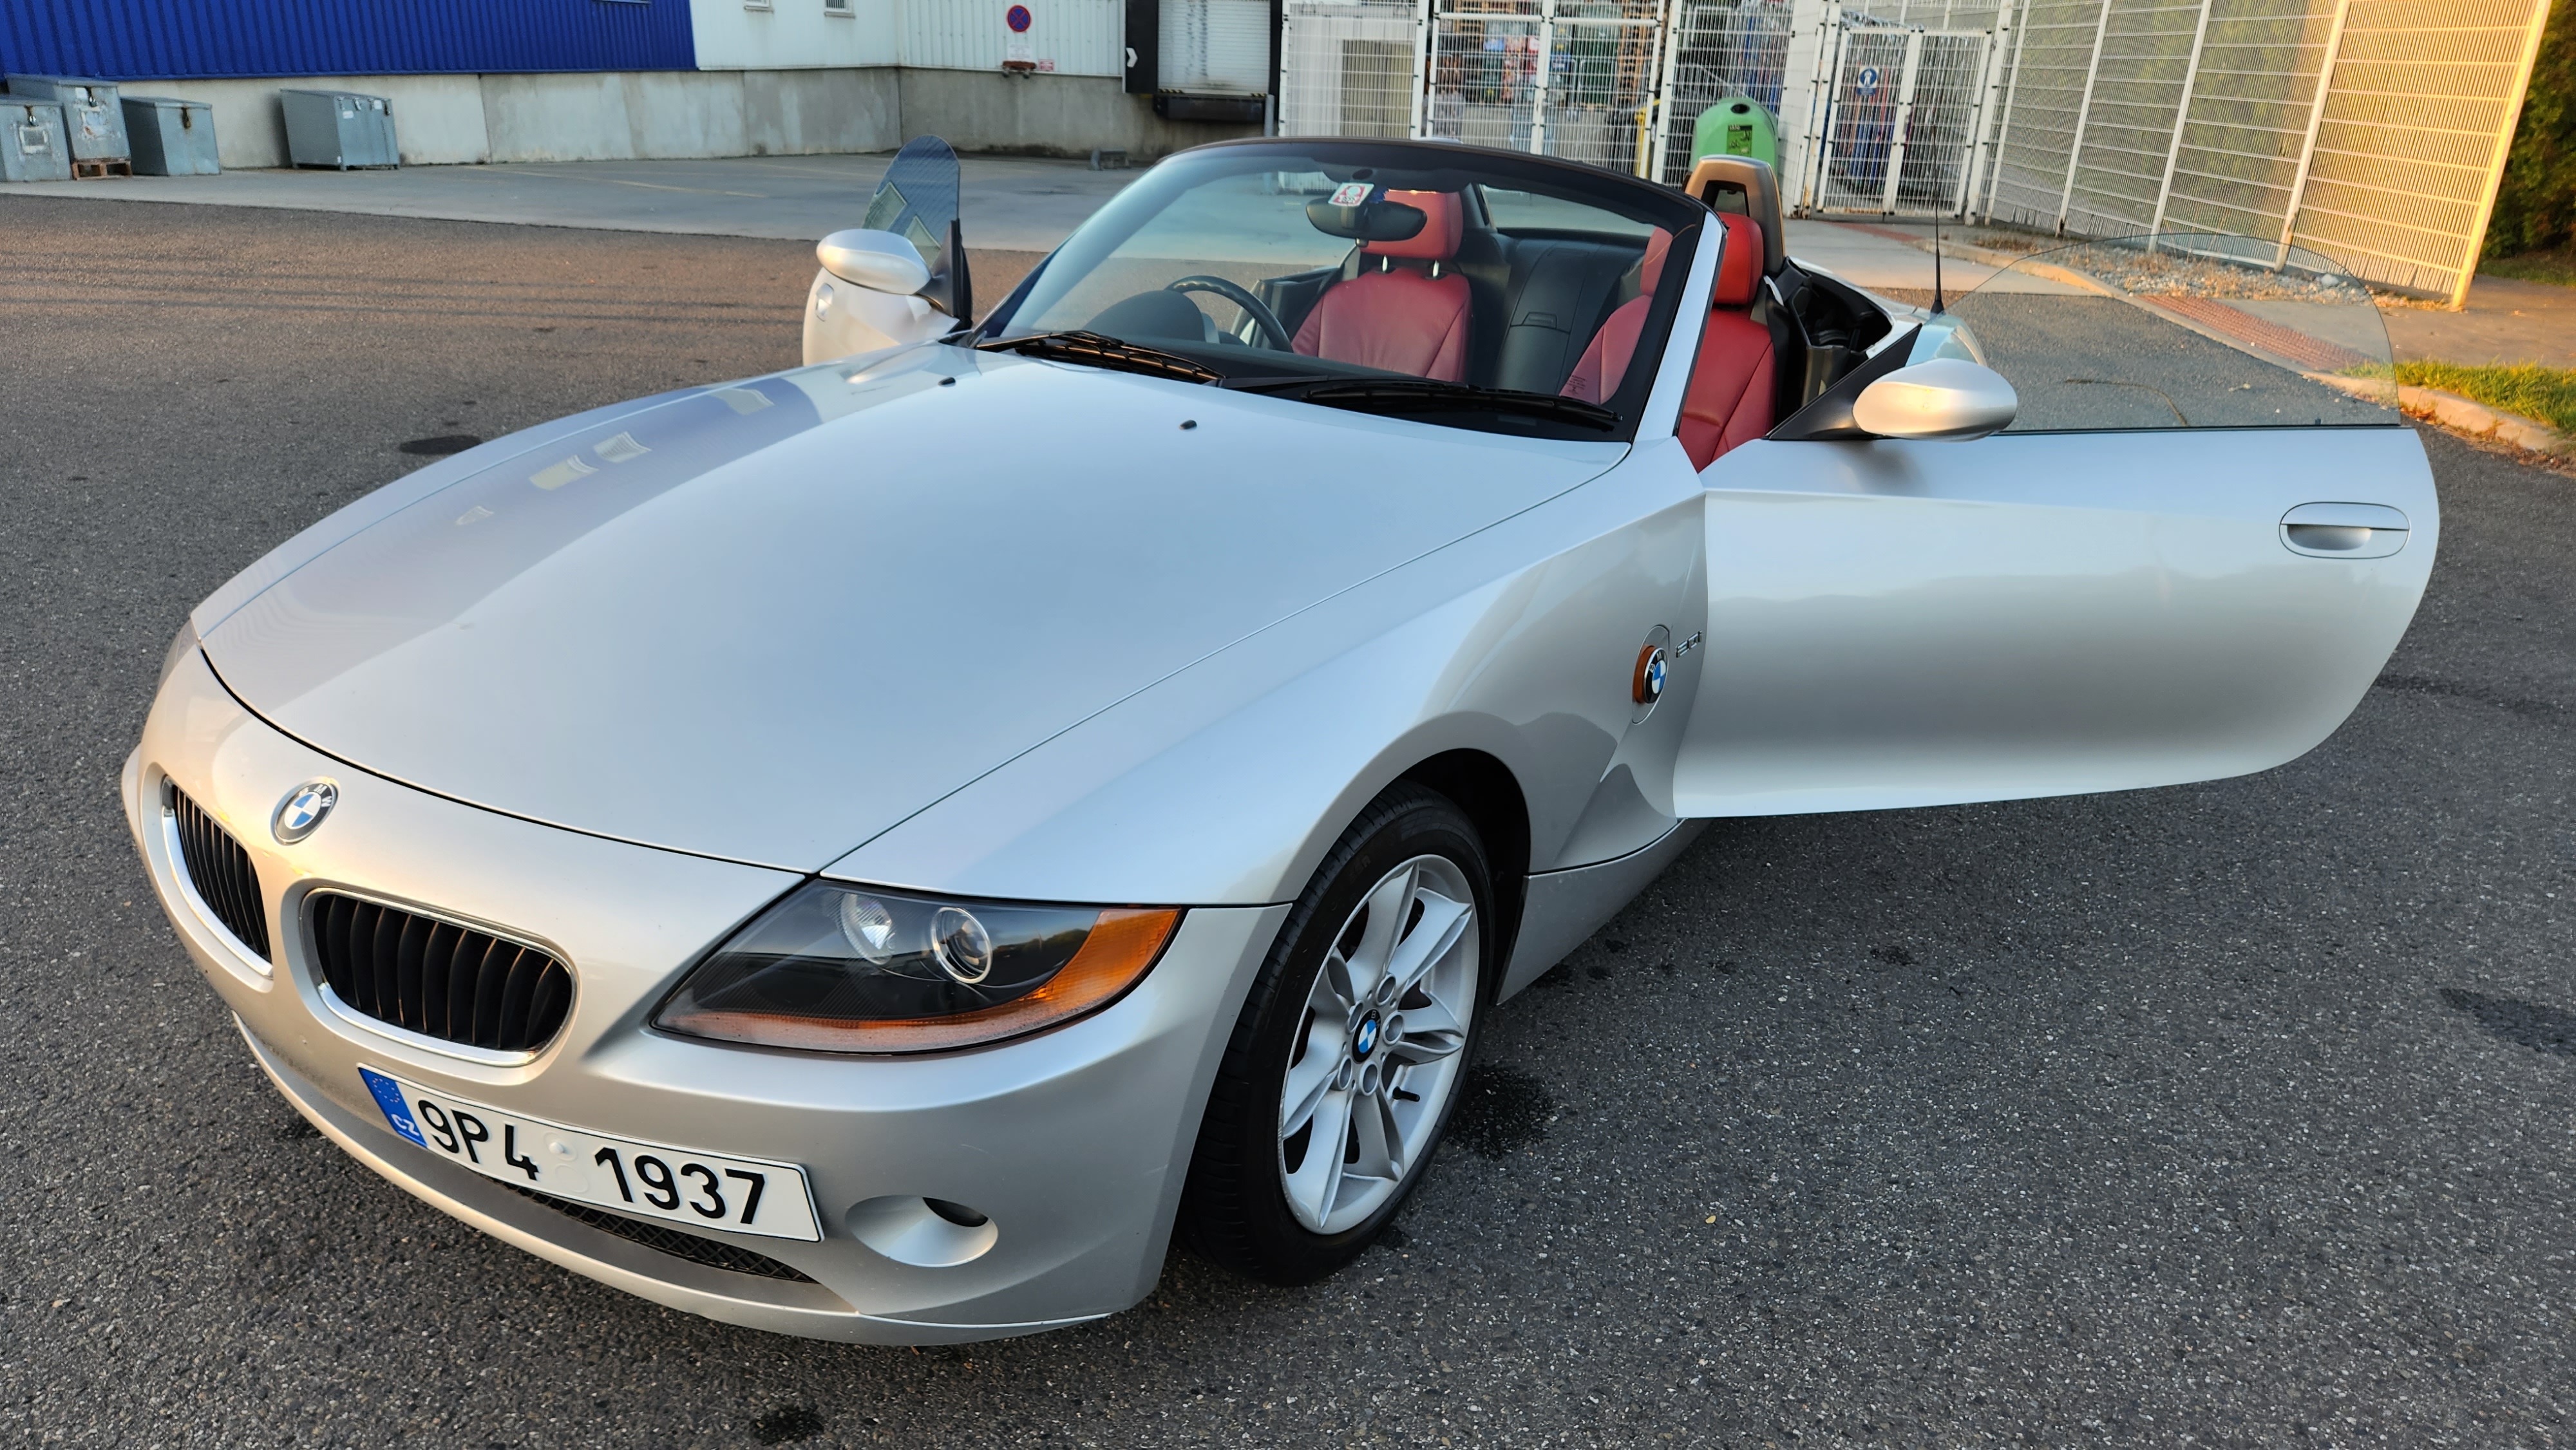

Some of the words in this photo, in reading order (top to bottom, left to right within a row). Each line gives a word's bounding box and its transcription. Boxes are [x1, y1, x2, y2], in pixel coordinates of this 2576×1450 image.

[391, 1114, 420, 1136] CZ
[418, 1100, 540, 1182] 9P4
[594, 1147, 765, 1225] 1937
